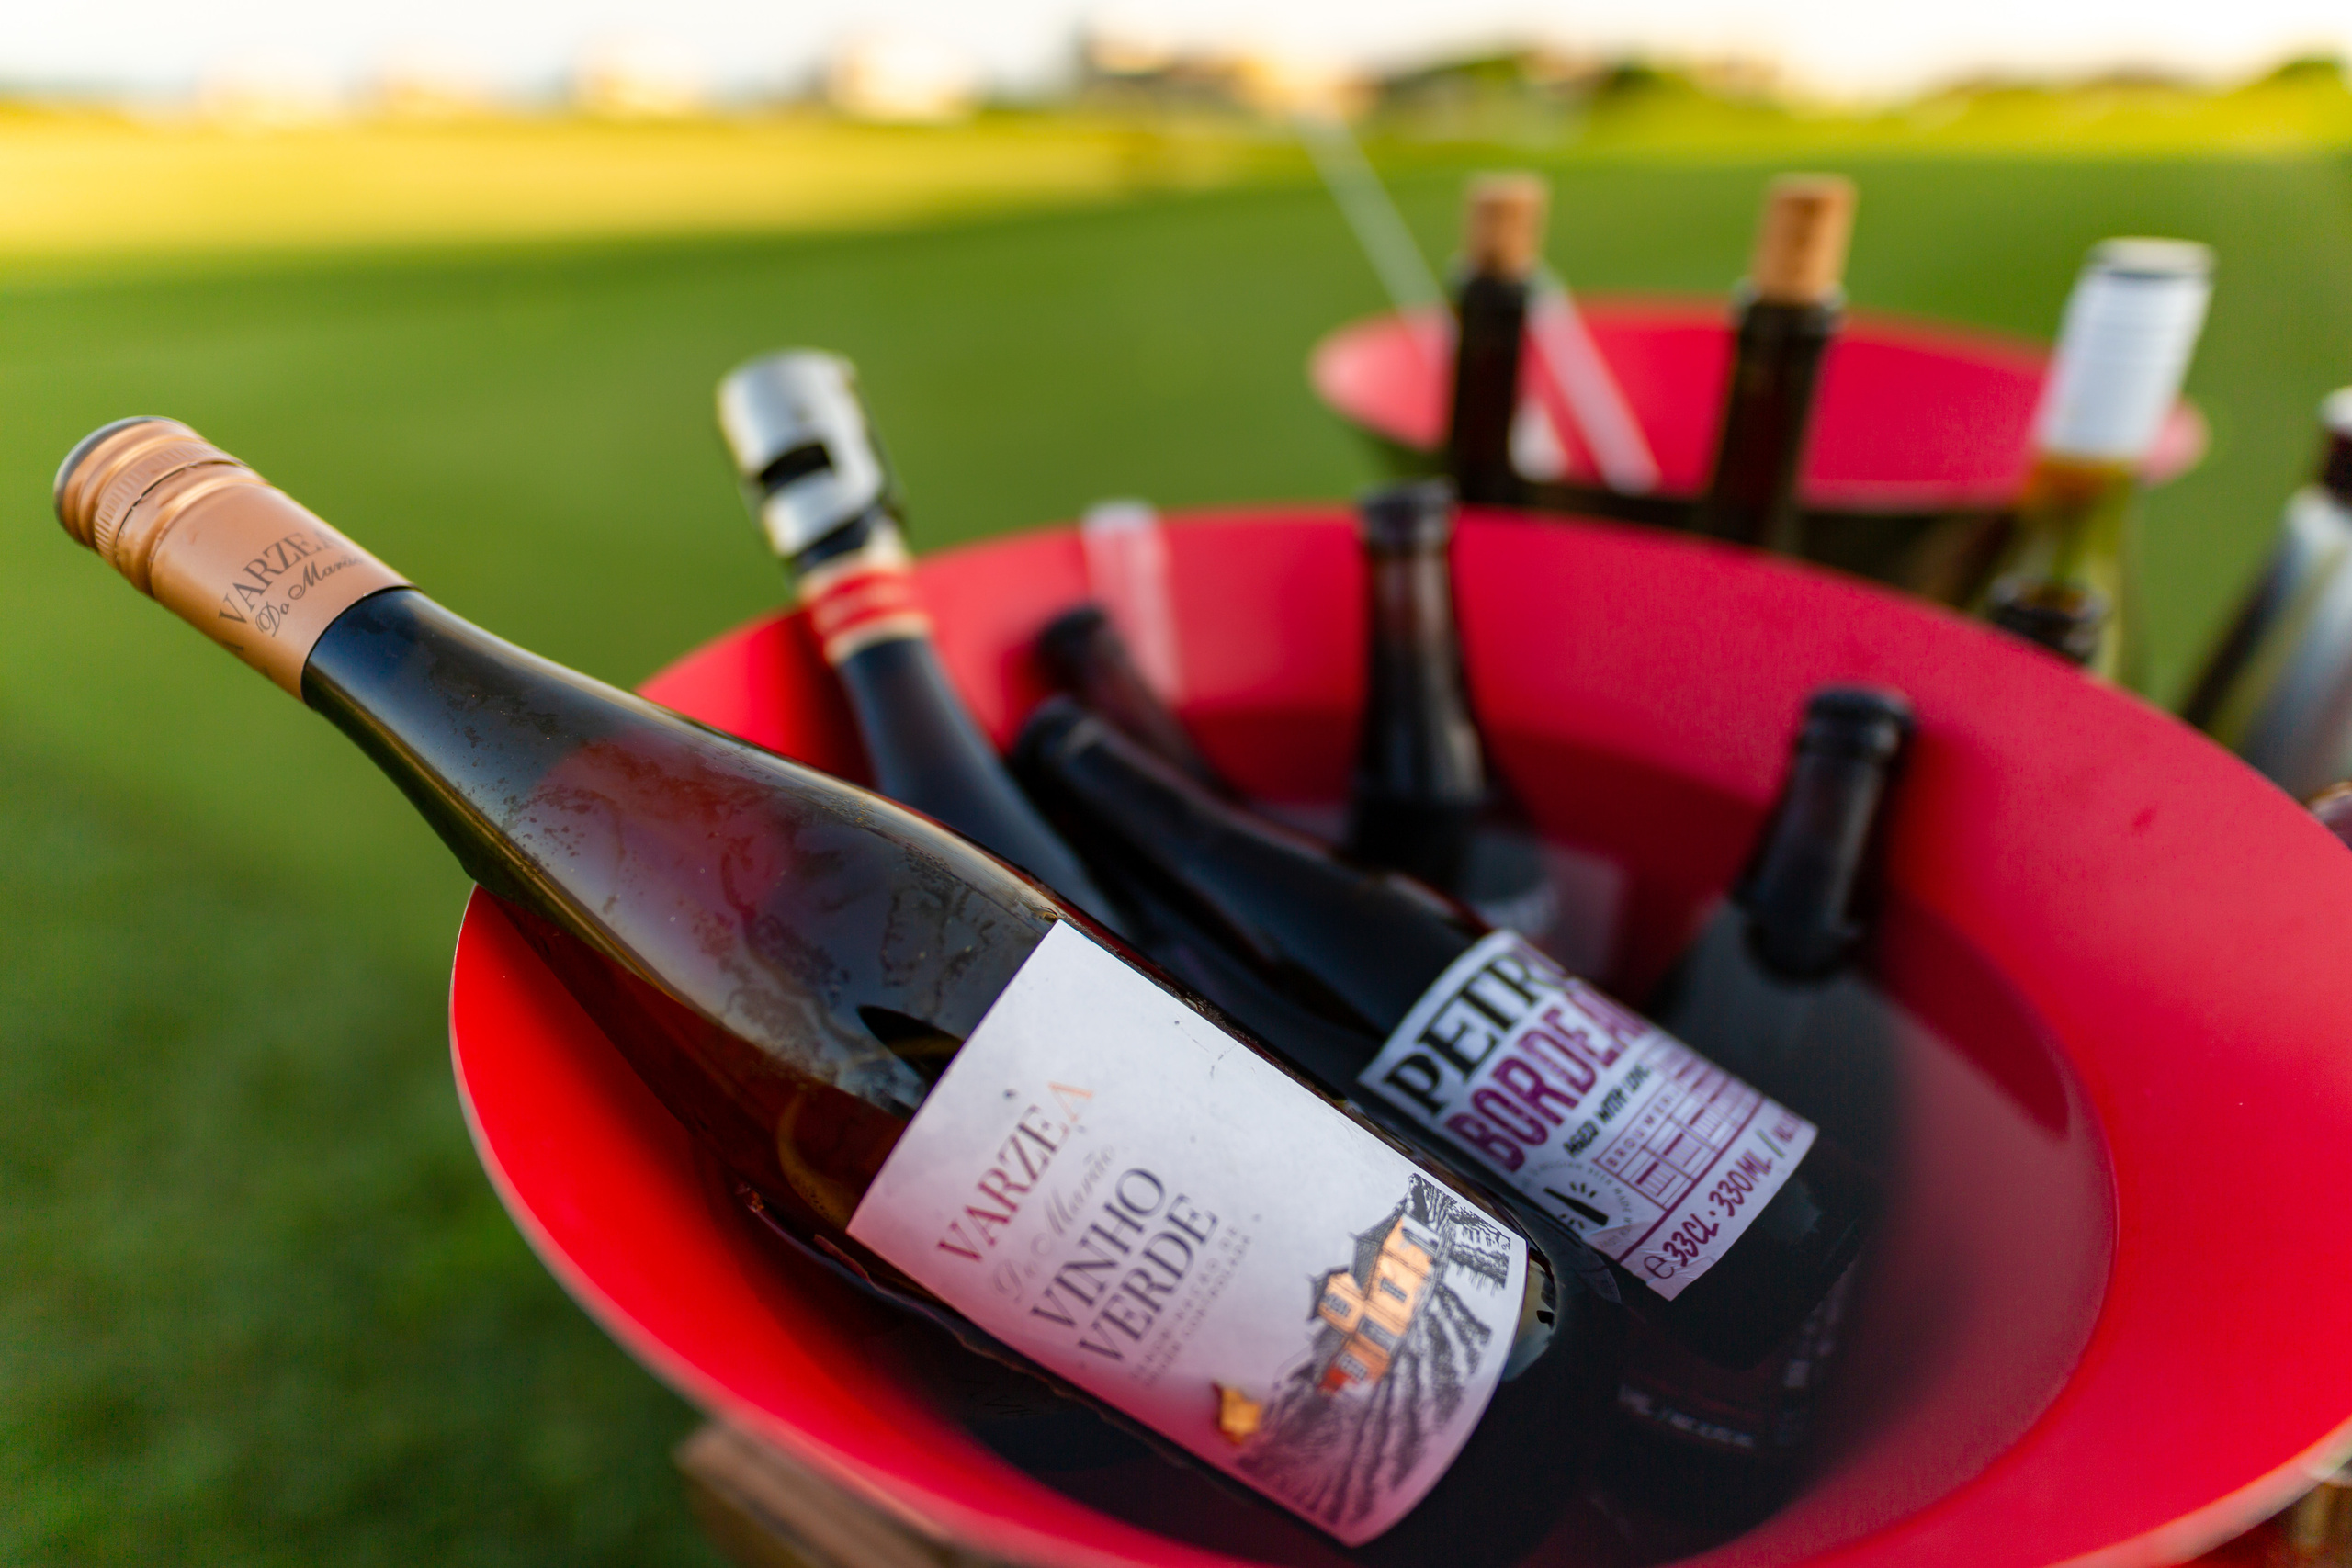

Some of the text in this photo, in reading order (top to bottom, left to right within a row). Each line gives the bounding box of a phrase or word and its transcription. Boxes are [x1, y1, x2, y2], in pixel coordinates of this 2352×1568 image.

[1383, 952, 1566, 1115] PETR
[1444, 990, 1646, 1172] BORDEA
[936, 1082, 1095, 1261] VARZEA
[1031, 1168, 1166, 1328] VINHO
[1078, 1193, 1219, 1361] VERDE
